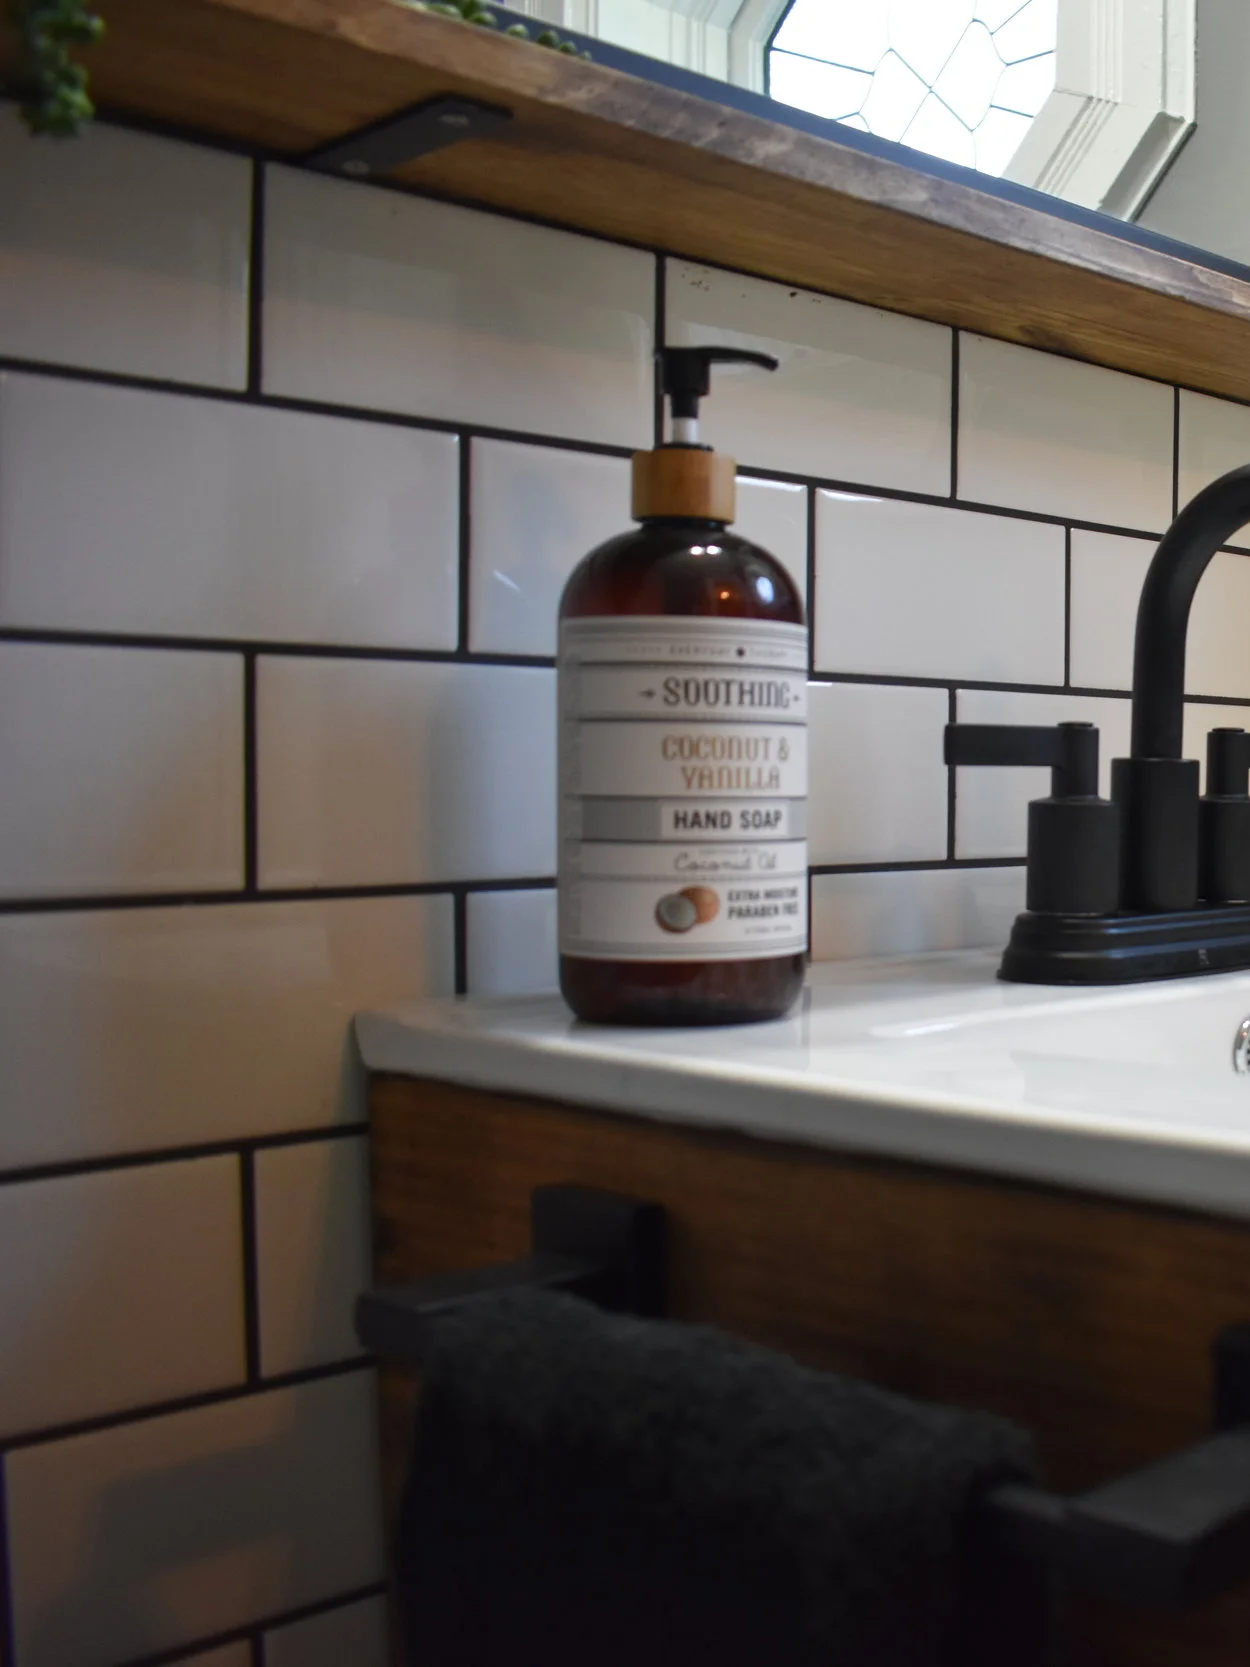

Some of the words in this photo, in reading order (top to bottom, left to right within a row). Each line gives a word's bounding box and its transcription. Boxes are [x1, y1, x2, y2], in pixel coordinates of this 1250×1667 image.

[663, 677, 790, 709] SOOTHING
[661, 735, 772, 762] COCONUT
[778, 736, 789, 762] &
[681, 766, 780, 790] VANILLA
[674, 809, 732, 830] HAND
[740, 809, 782, 830] SOAP
